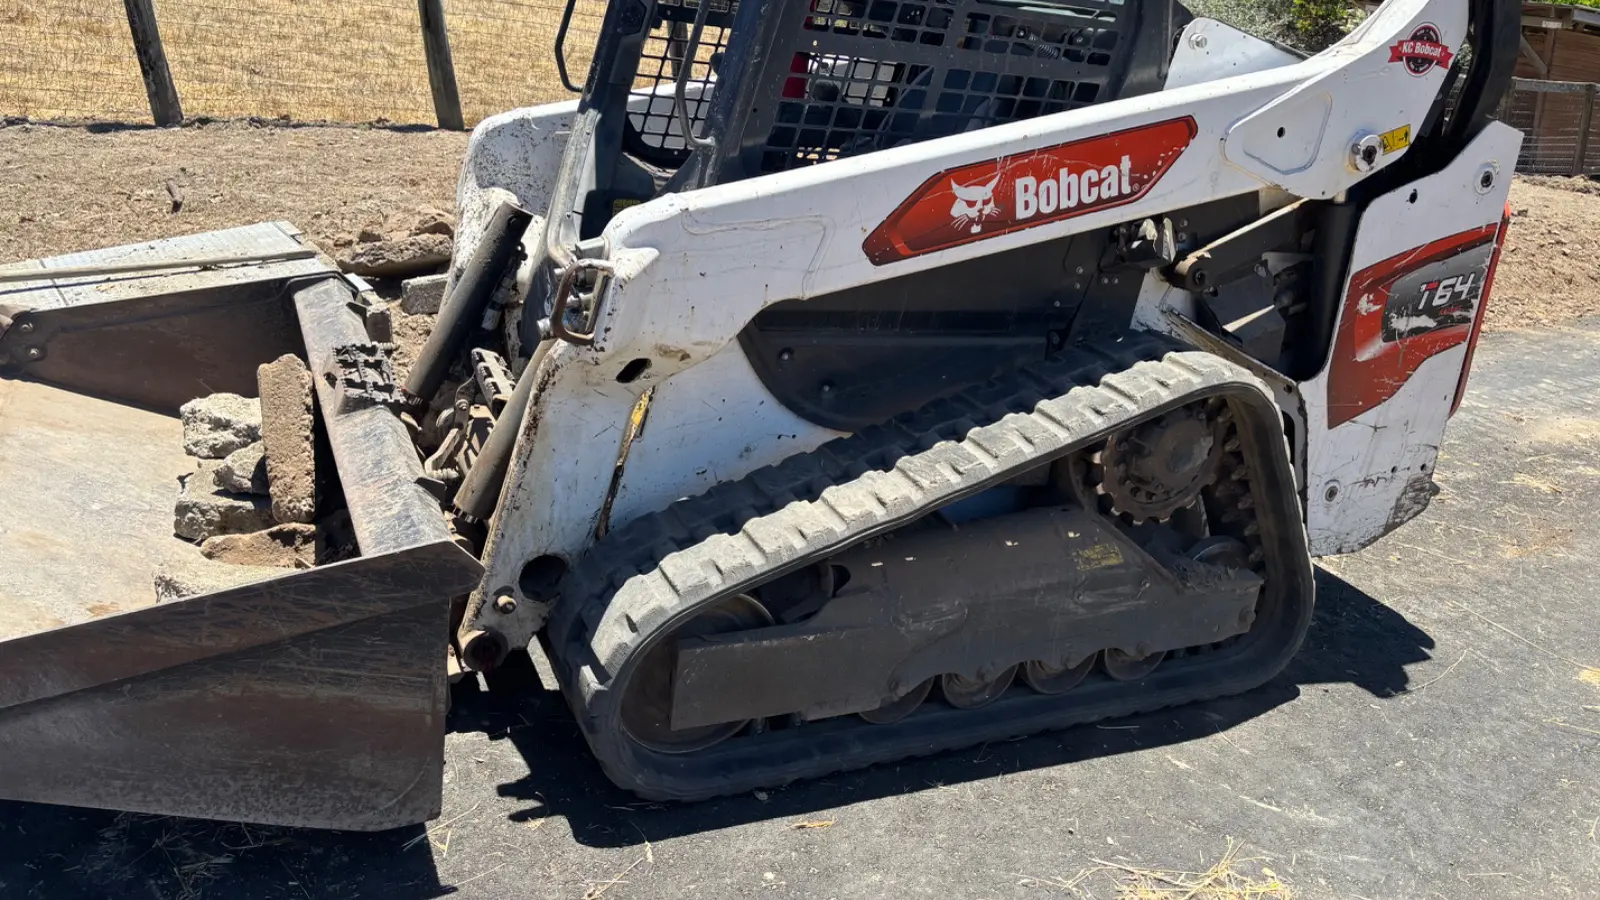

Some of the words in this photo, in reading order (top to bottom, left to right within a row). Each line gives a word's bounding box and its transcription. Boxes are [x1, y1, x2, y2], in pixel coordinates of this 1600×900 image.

[1402, 41, 1414, 54] KC
[1414, 42, 1442, 58] Bobcat
[1015, 154, 1131, 220] Bobcat
[1418, 273, 1475, 310] T64
